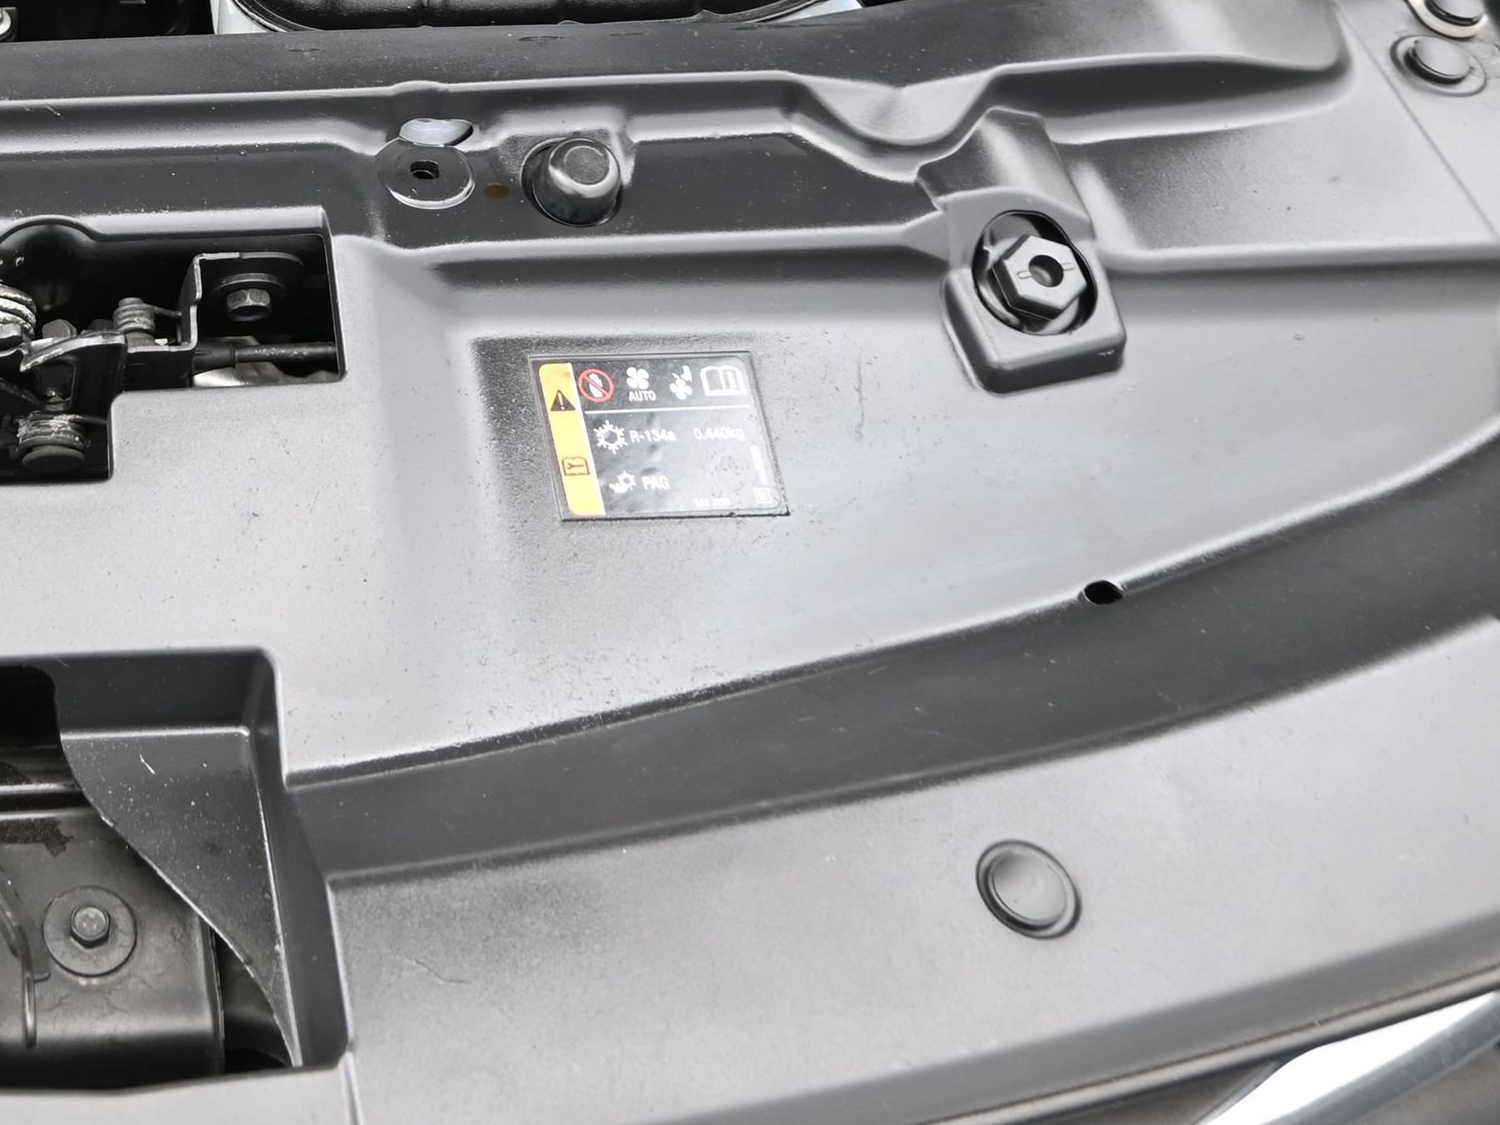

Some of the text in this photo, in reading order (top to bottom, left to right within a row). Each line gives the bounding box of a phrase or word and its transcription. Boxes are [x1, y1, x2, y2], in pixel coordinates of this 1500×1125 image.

[628, 390, 656, 402] AUTO
[630, 428, 676, 443] R-134a
[642, 476, 670, 491] PAG
